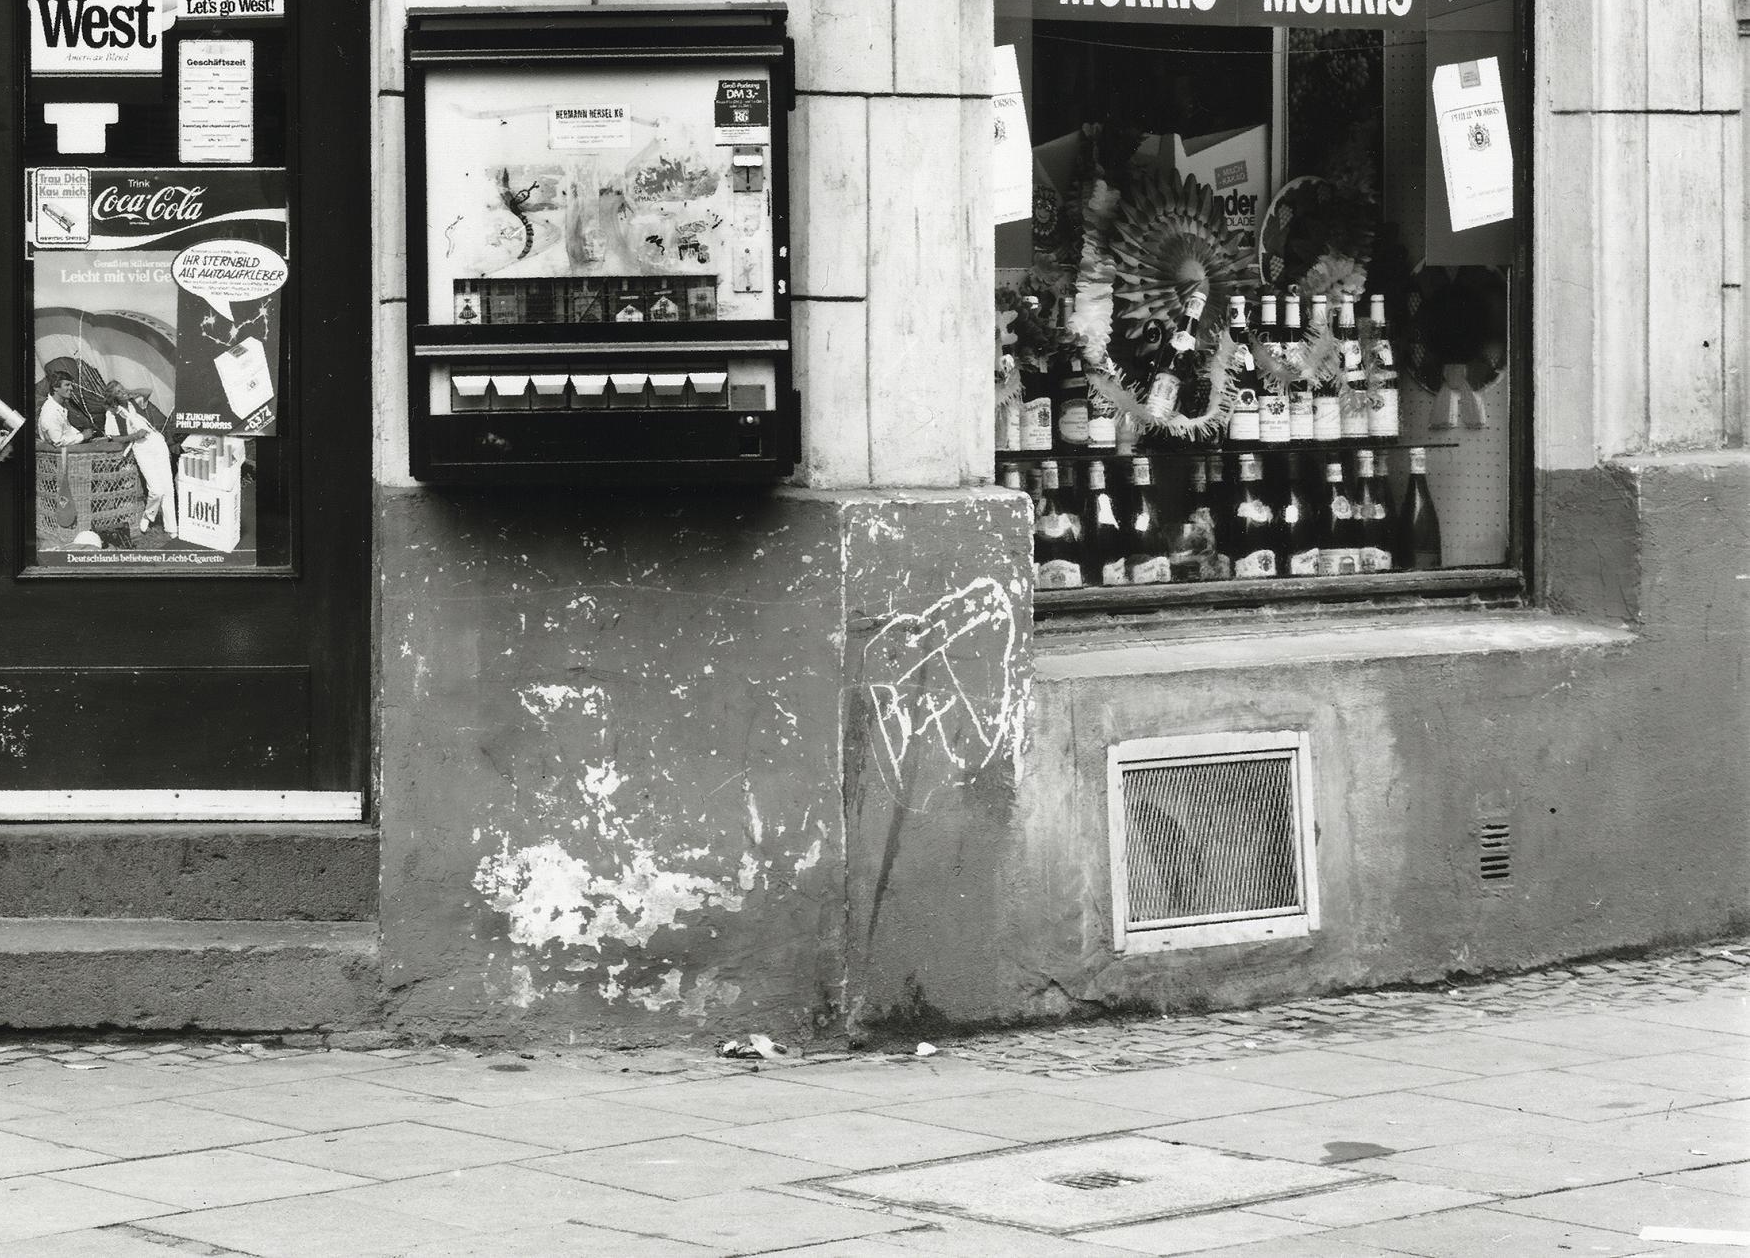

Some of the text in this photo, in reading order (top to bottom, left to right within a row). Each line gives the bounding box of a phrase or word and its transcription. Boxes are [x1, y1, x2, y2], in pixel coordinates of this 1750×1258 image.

[219, 0, 236, 17] go
[186, 58, 247, 67] Geschäftszeit
[726, 89, 745, 99] DM
[994, 97, 1017, 109] ORRIS
[39, 173, 86, 185] Trau Dich
[128, 179, 151, 188] Trink
[39, 186, 86, 197] Kau mich
[92, 186, 208, 221] Coca-Cola
[1212, 189, 1258, 216] nder
[203, 255, 261, 268] STERNBILD
[61, 269, 172, 283] Leicht mit viel Ge
[178, 267, 285, 281] ALS AUTOAUFKLEBER
[176, 413, 221, 422] IN ZUKUNFT
[176, 421, 233, 430] PHILIP MORRIS
[187, 491, 220, 525] Lord
[67, 553, 119, 563] Deutschlands
